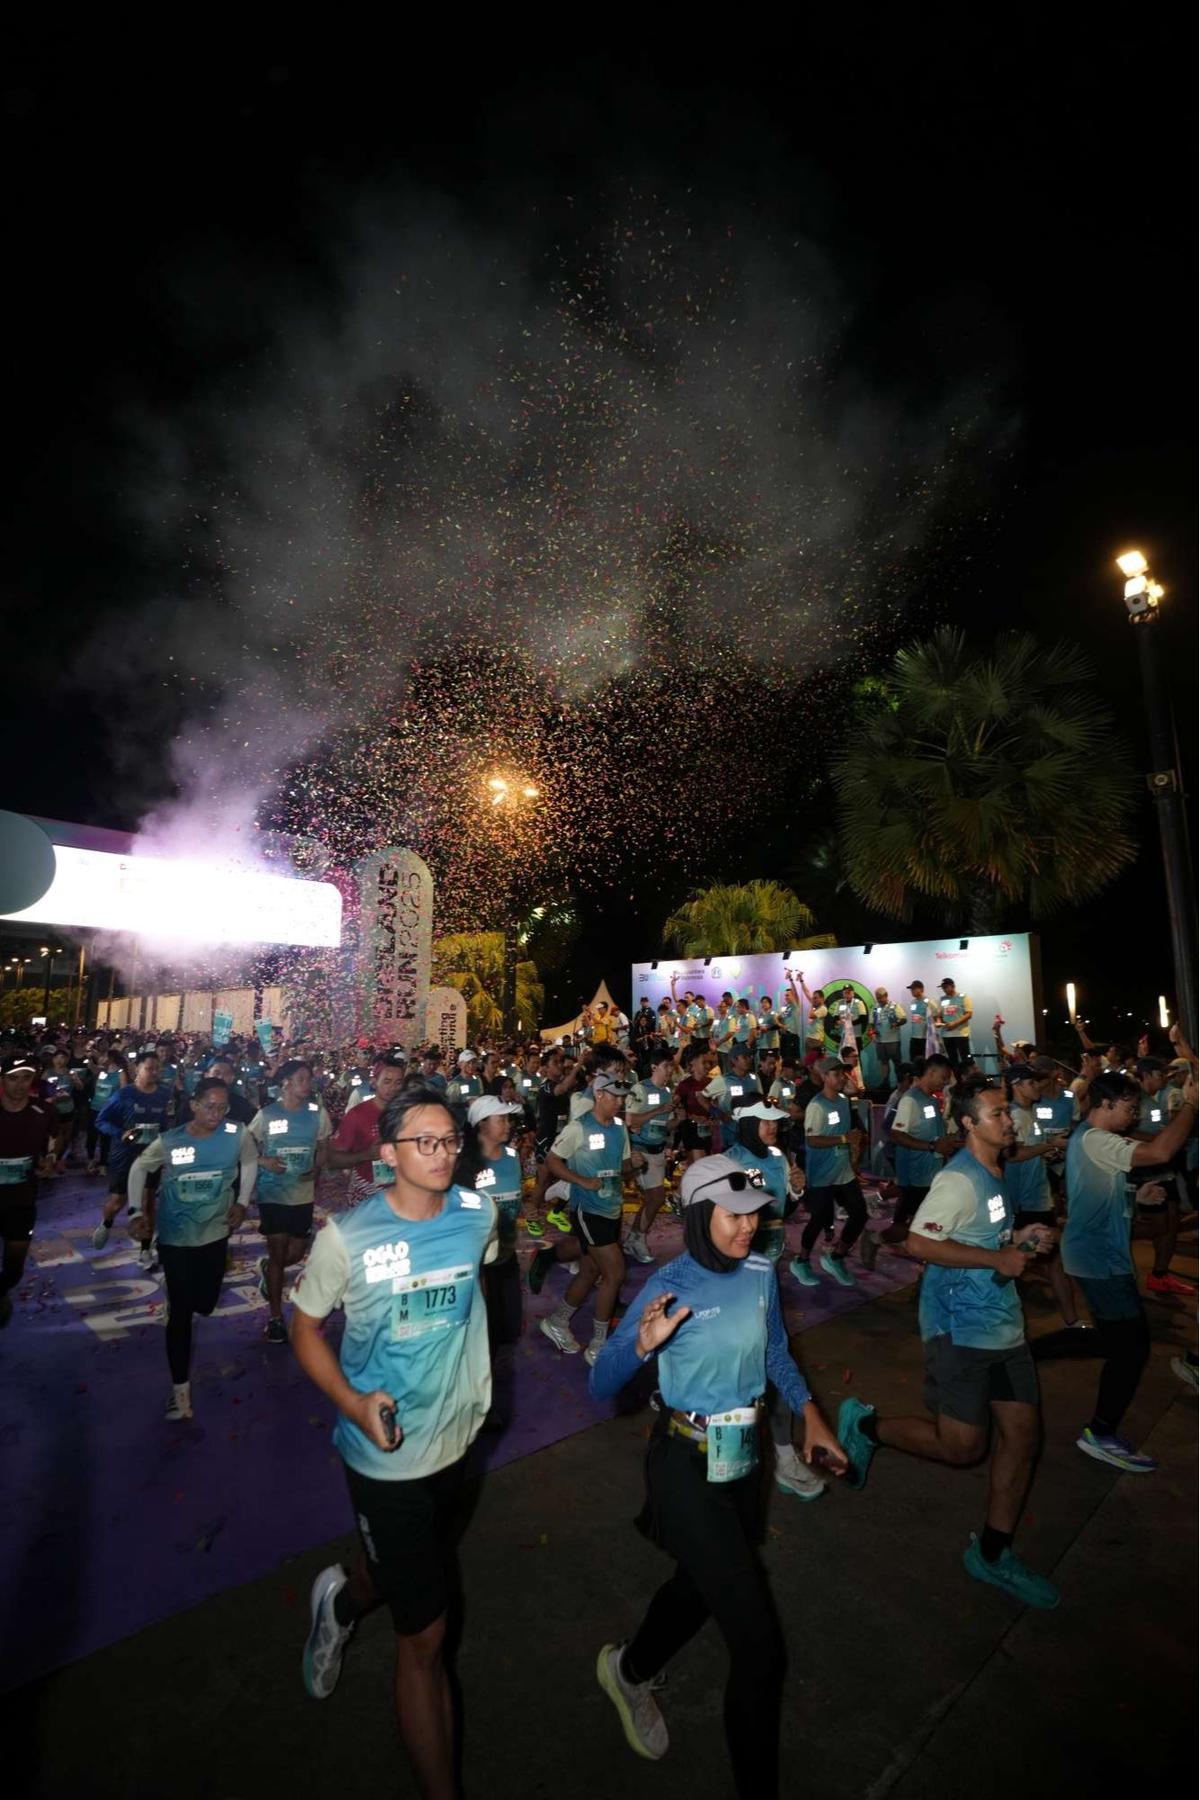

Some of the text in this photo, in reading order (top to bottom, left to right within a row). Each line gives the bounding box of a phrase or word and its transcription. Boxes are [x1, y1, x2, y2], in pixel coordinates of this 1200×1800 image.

[397, 952, 418, 1019] RUN
[401, 1293, 409, 1306] B
[425, 1285, 456, 1310] 1773
[400, 1309, 409, 1322] M
[715, 1426, 722, 1441] B
[716, 1445, 721, 1459] F
